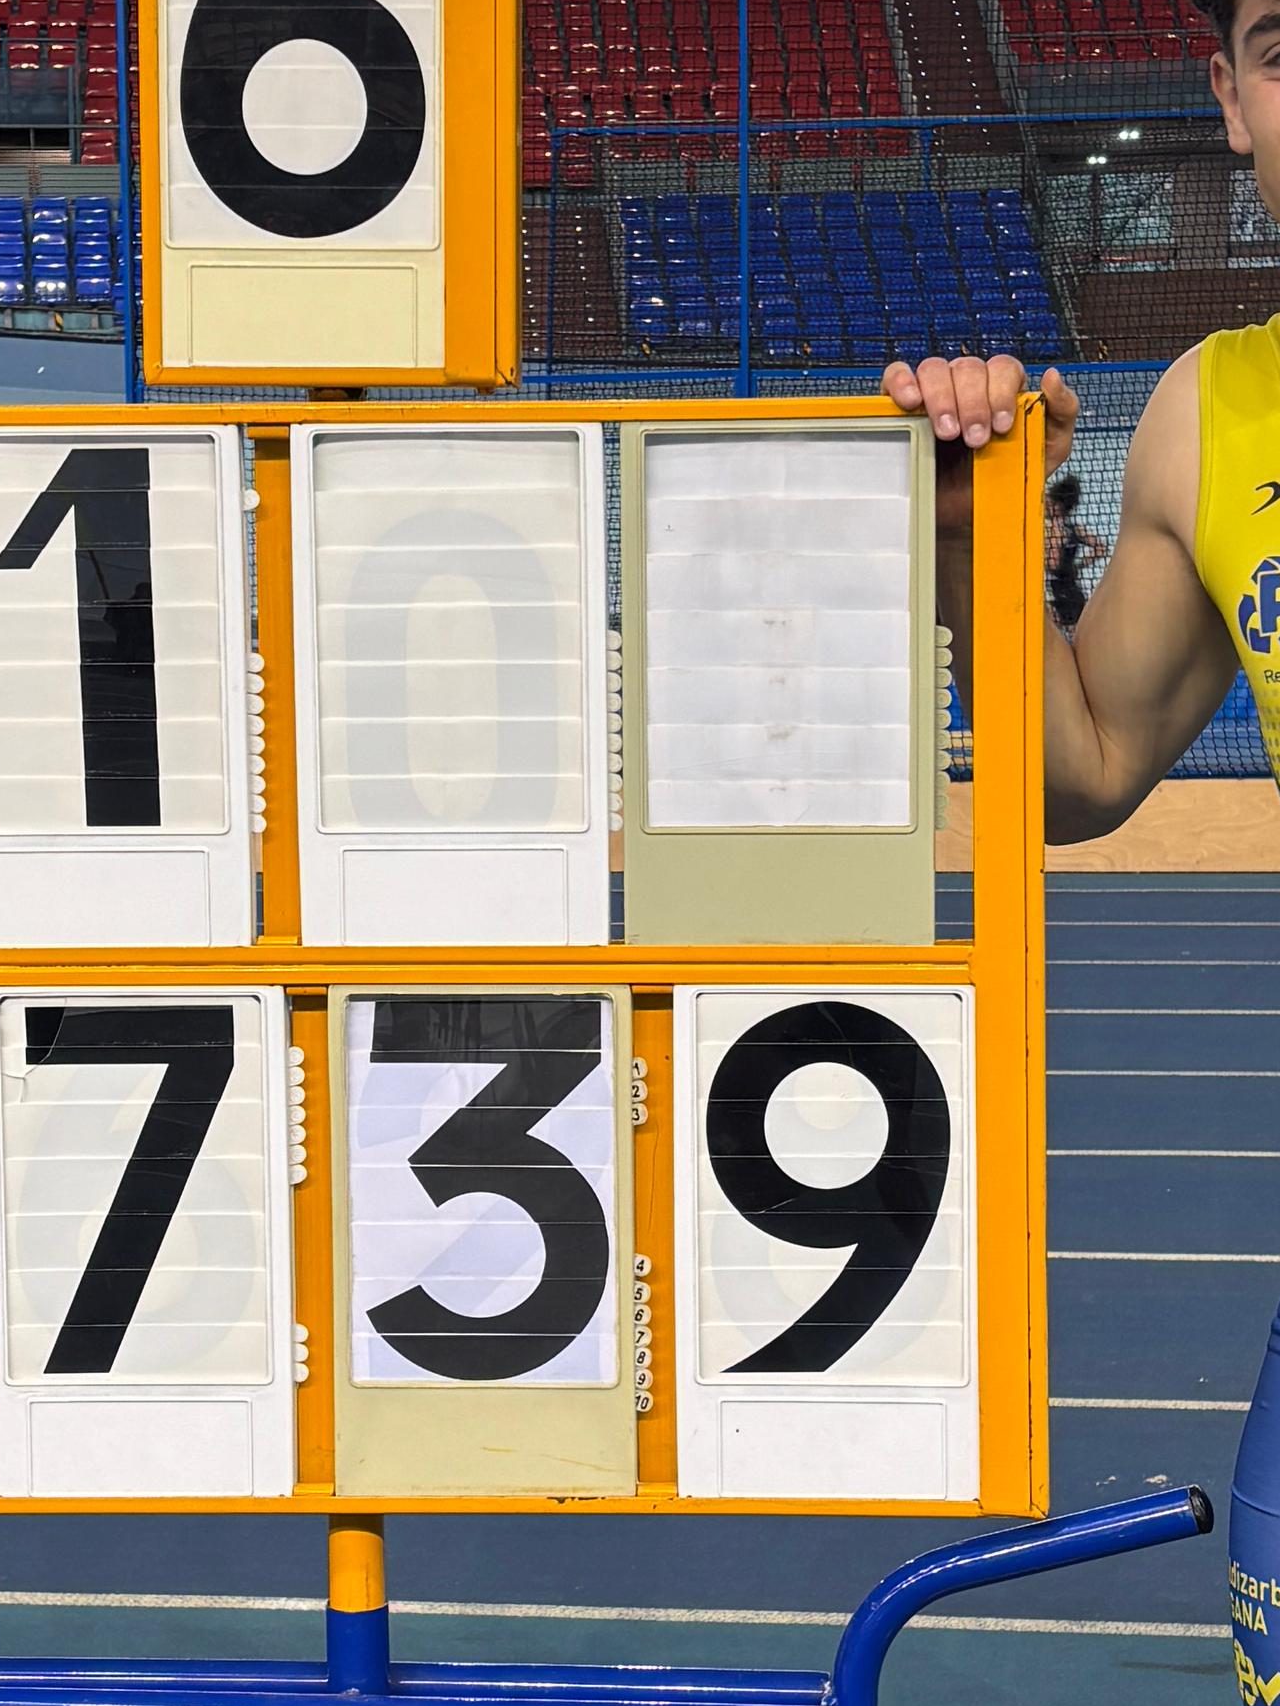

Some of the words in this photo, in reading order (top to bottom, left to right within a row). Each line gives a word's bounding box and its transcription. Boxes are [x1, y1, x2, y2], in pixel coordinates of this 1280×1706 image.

[25, 1006, 234, 1373] 7
[366, 1001, 609, 1381] 3
[707, 1002, 950, 1373] 9
